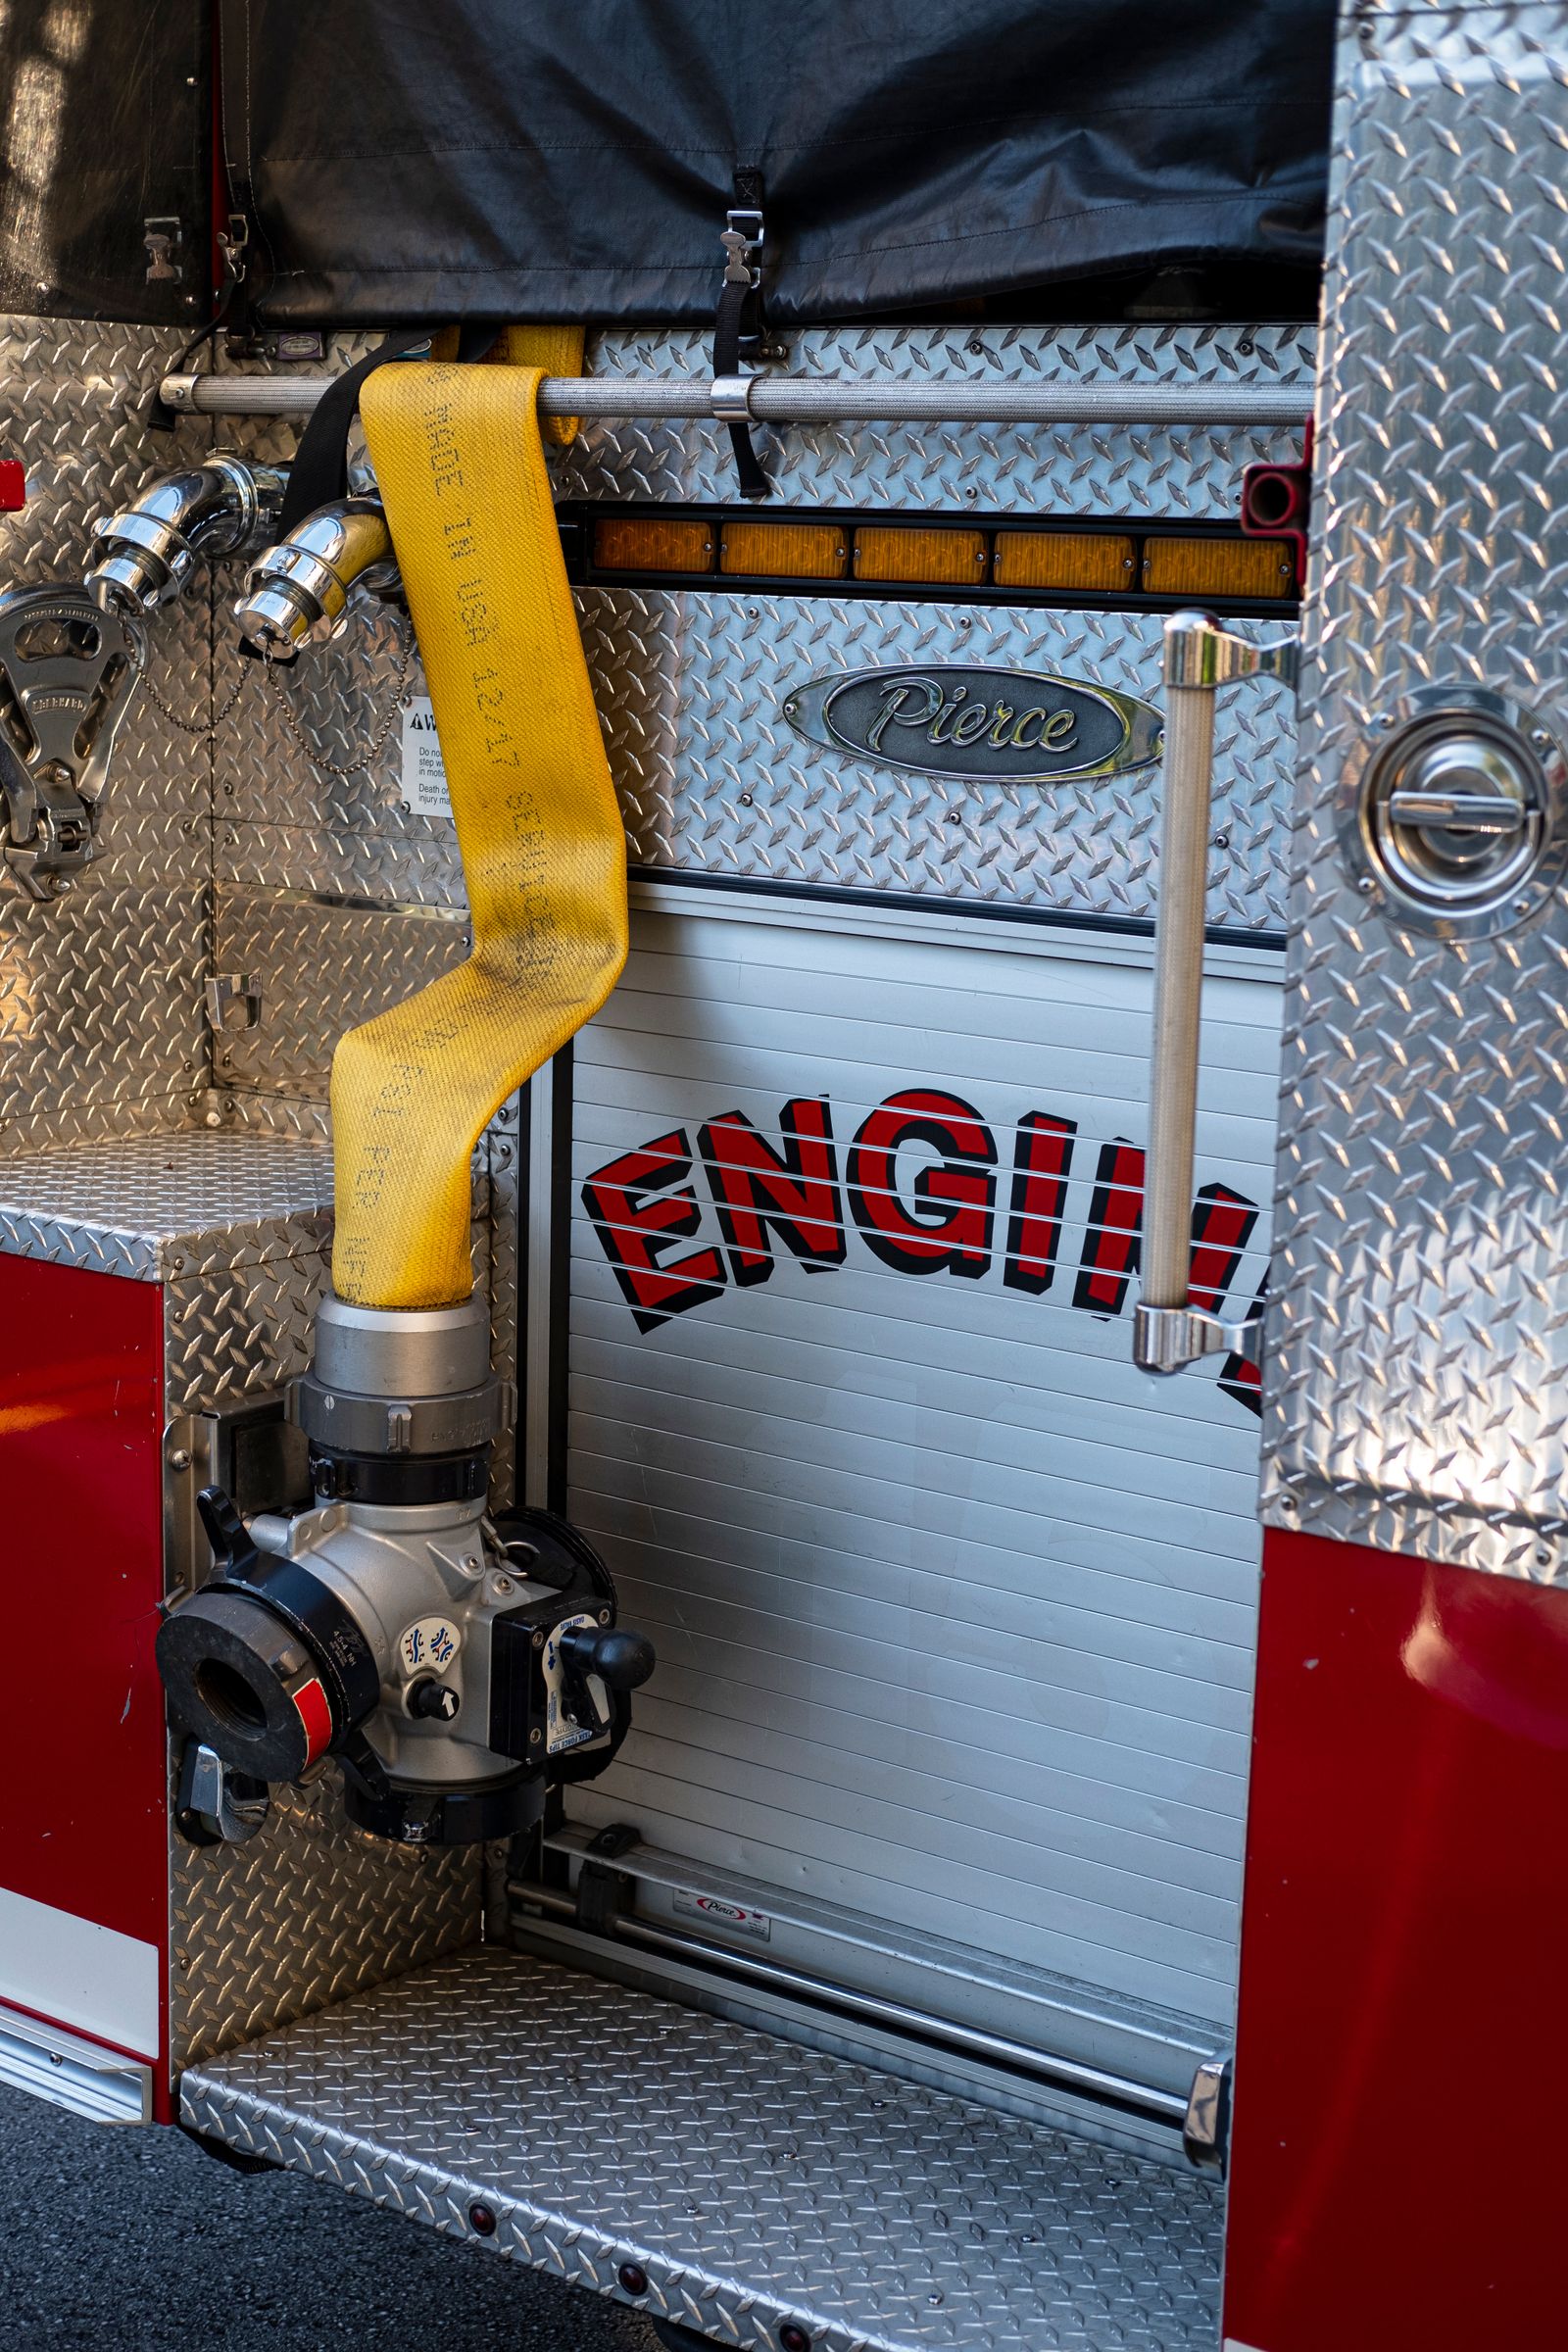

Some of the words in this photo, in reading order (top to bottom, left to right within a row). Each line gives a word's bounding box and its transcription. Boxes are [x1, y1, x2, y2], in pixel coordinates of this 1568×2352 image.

[423, 403, 465, 497] MADE
[443, 517, 477, 561] IN
[457, 578, 491, 647] USA
[472, 668, 520, 767] 12/17
[864, 676, 1079, 754] Pierce
[418, 746, 430, 757] Do
[418, 758, 434, 768] step
[418, 783, 440, 794] Death
[418, 794, 437, 806] injury
[581, 1088, 1267, 1419] ENGIN
[708, 1901, 737, 1917] Pierce
